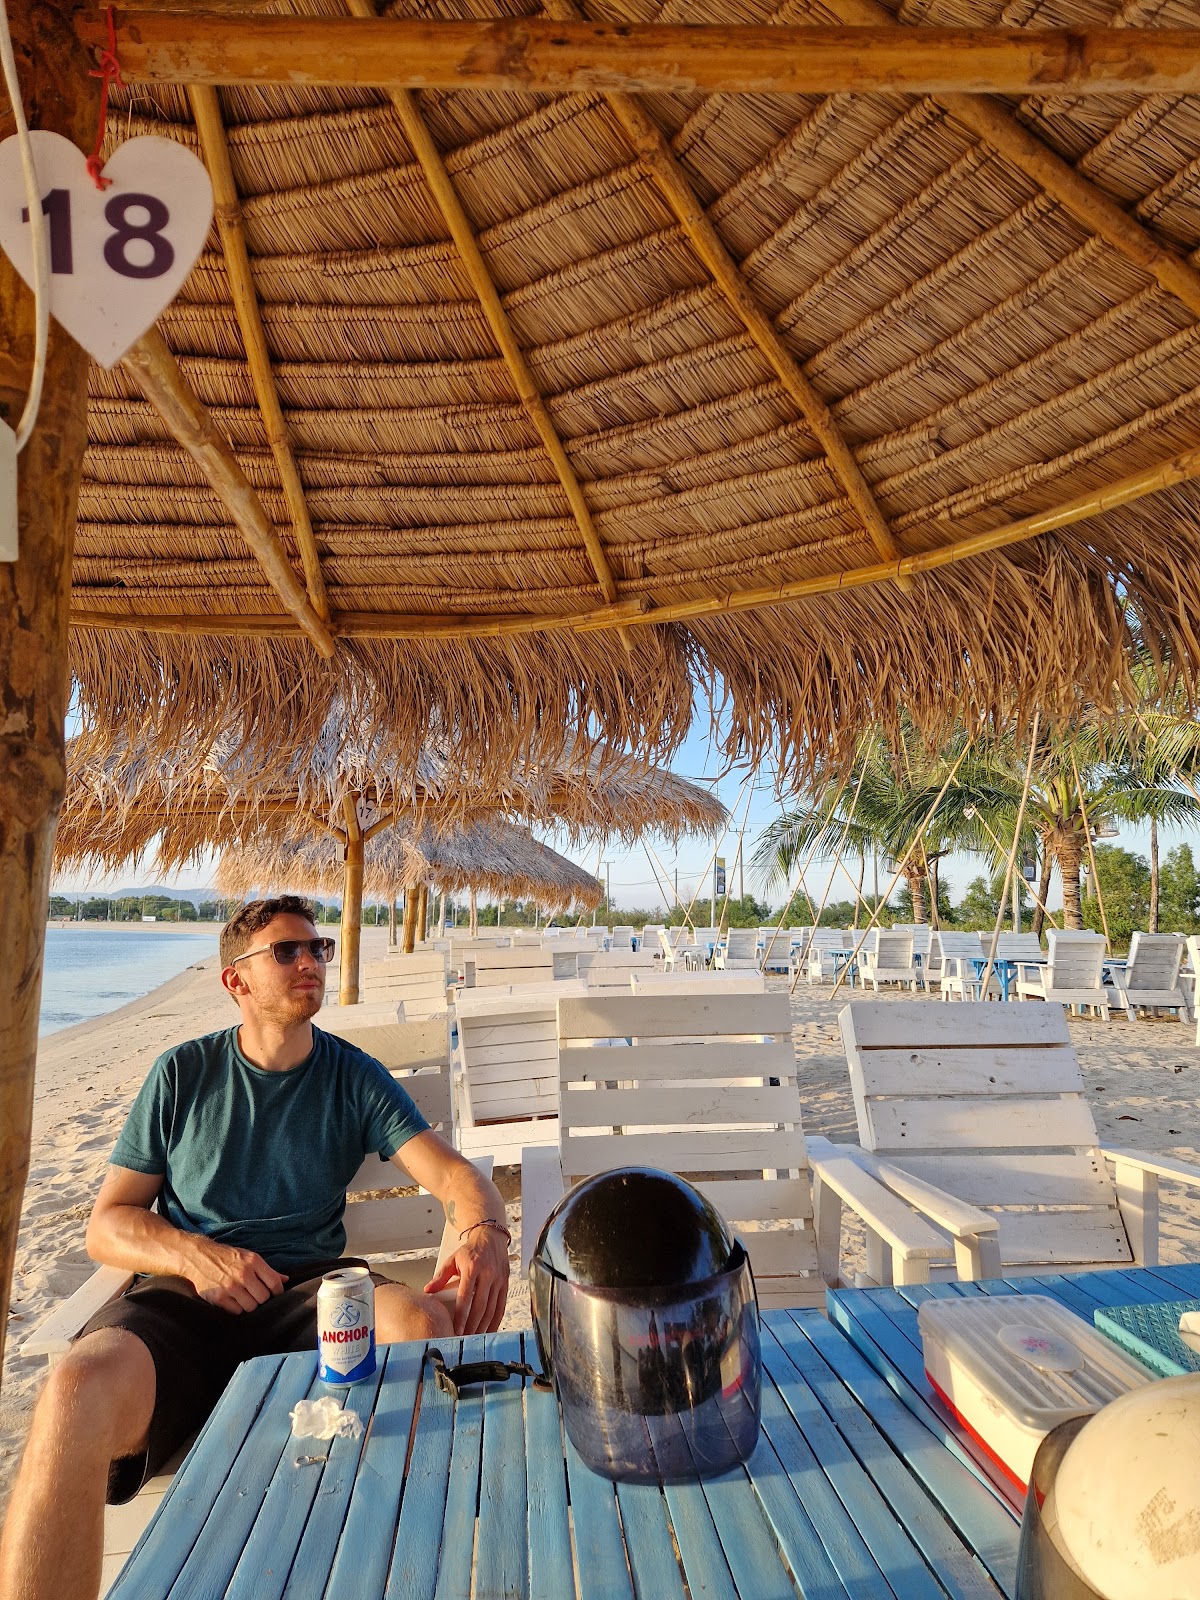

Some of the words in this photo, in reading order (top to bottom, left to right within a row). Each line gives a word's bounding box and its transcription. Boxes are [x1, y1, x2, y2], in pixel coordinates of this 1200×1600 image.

[22, 188, 175, 279] 18
[360, 806, 373, 819] 17
[322, 1325, 369, 1344] ANCHOR
[332, 1344, 361, 1355] WHITE
